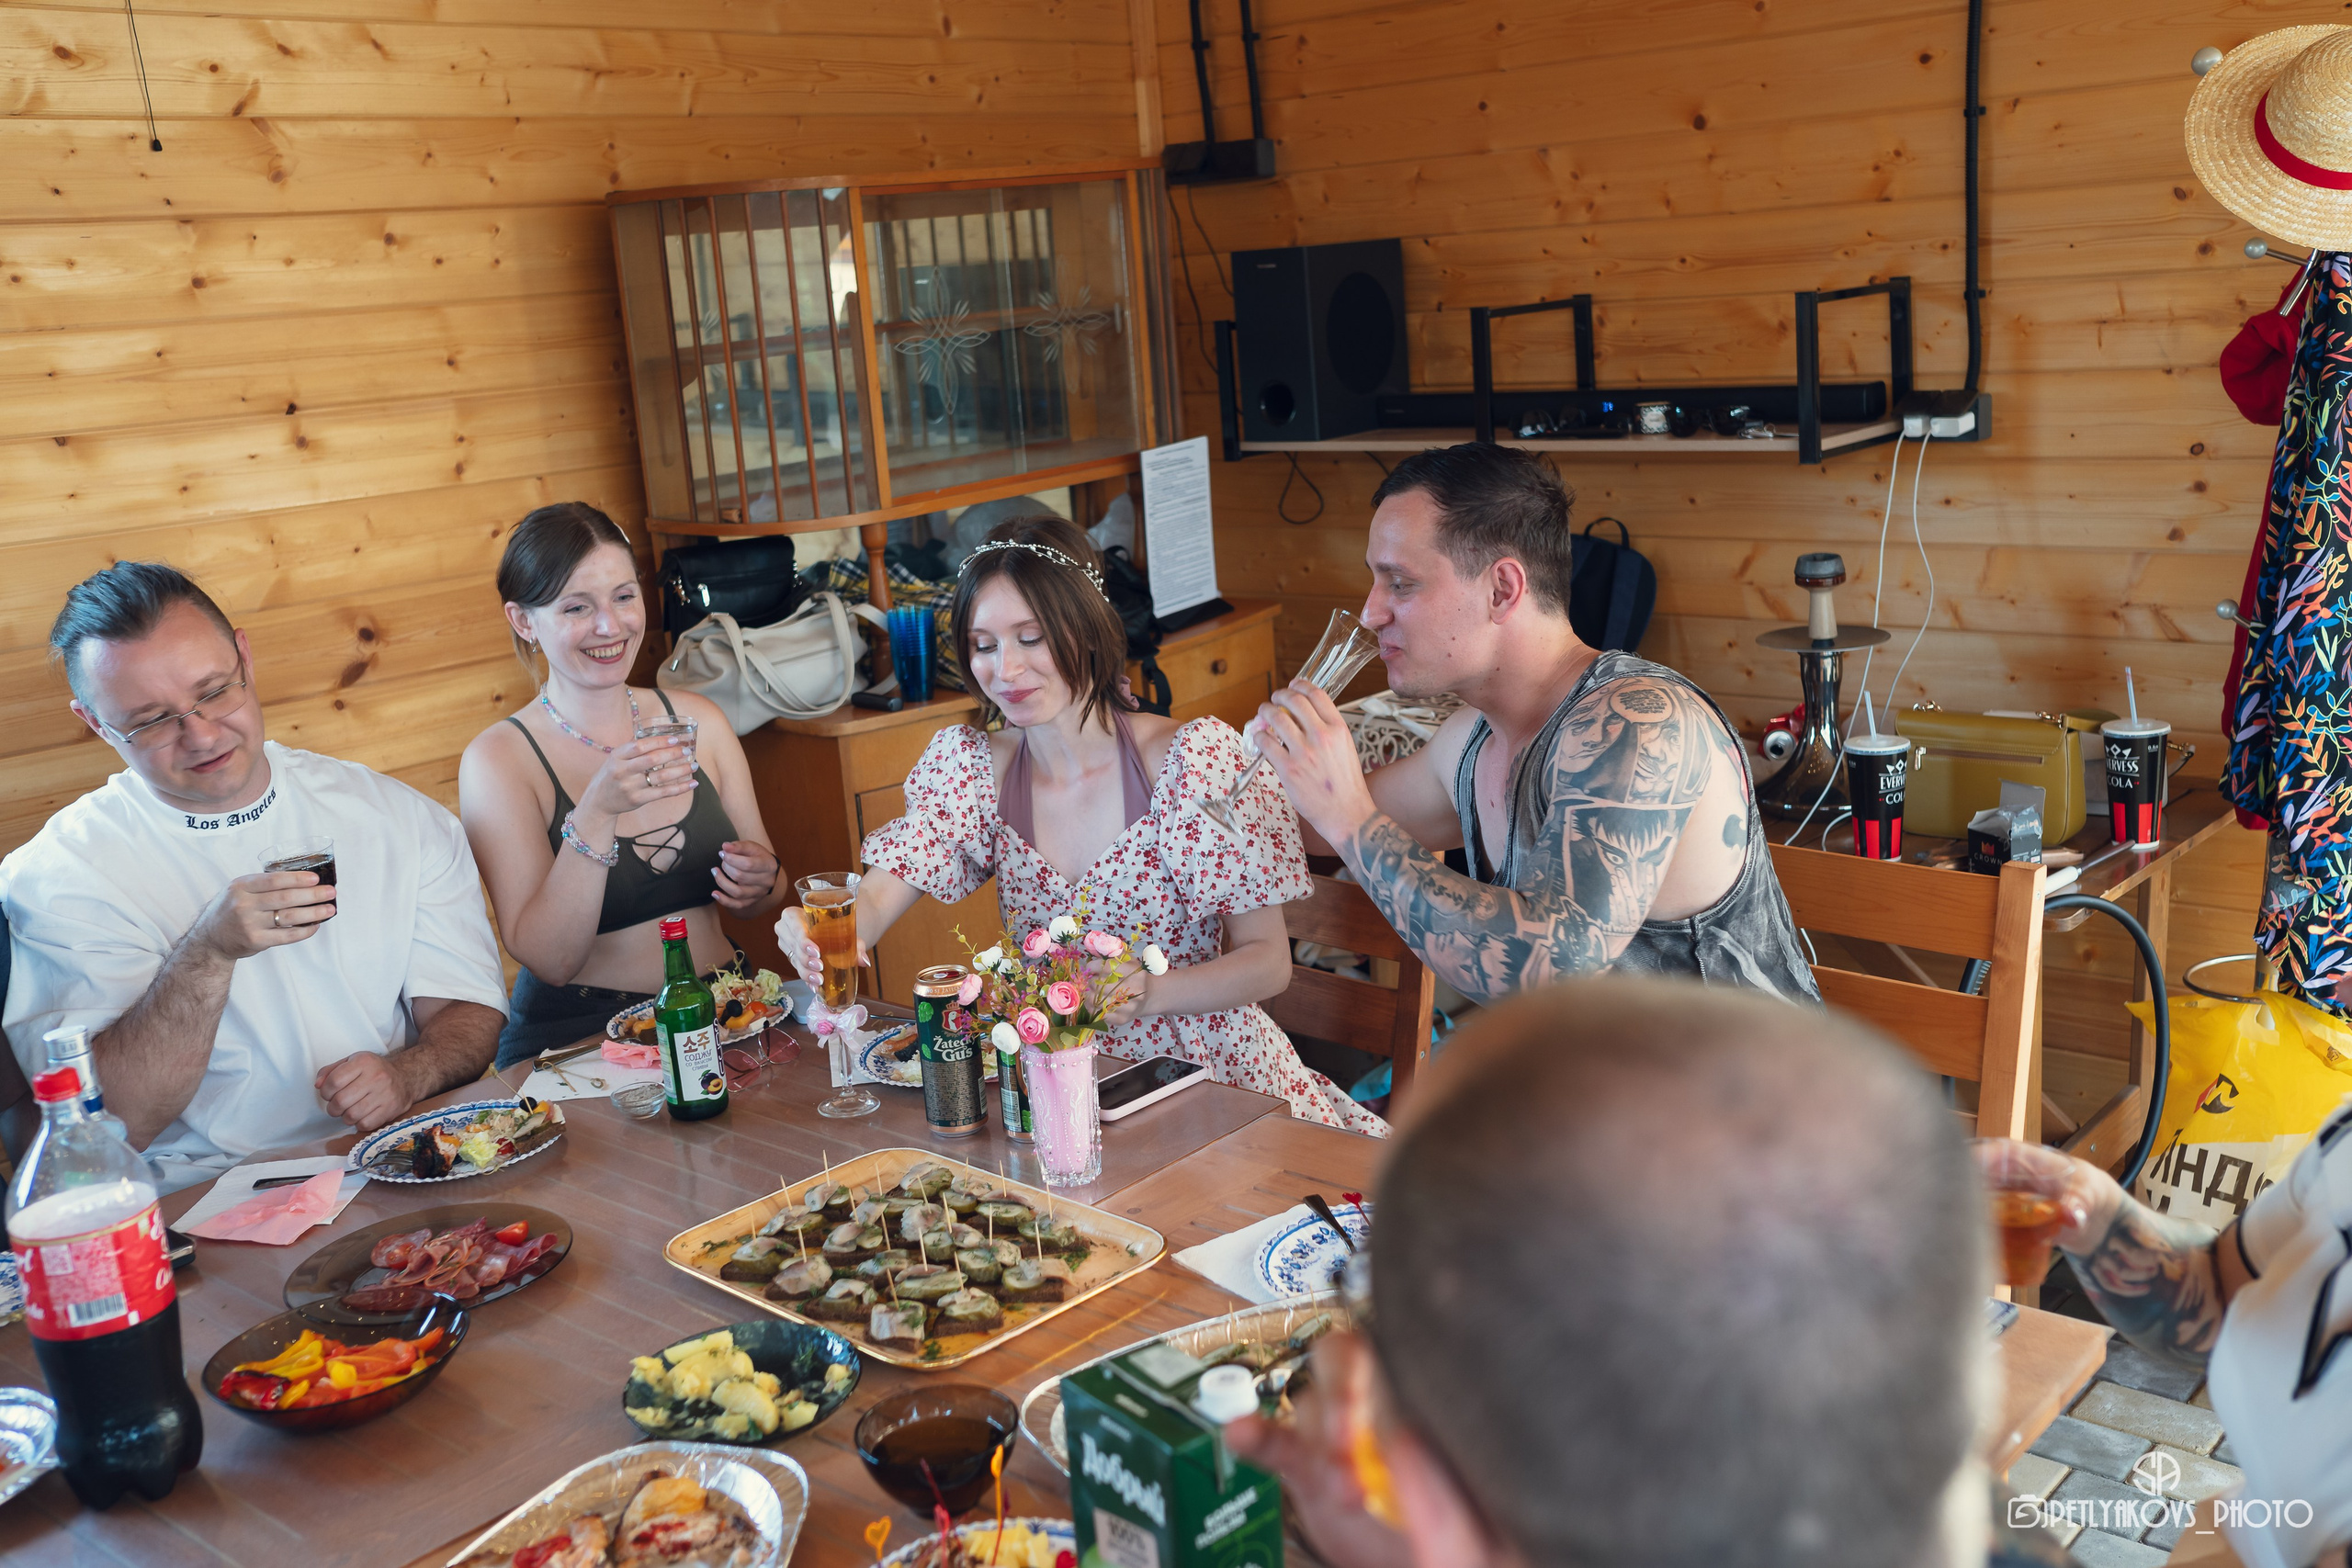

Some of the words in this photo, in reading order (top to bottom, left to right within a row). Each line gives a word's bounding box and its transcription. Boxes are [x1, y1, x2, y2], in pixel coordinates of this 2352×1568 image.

[1881, 773, 1906, 790] EVERV
[185, 815, 220, 830] Los
[226, 786, 277, 828] Angeles
[1973, 852, 2003, 865] CROWN
[683, 1031, 711, 1054] 소주
[942, 1047, 974, 1062] Gus
